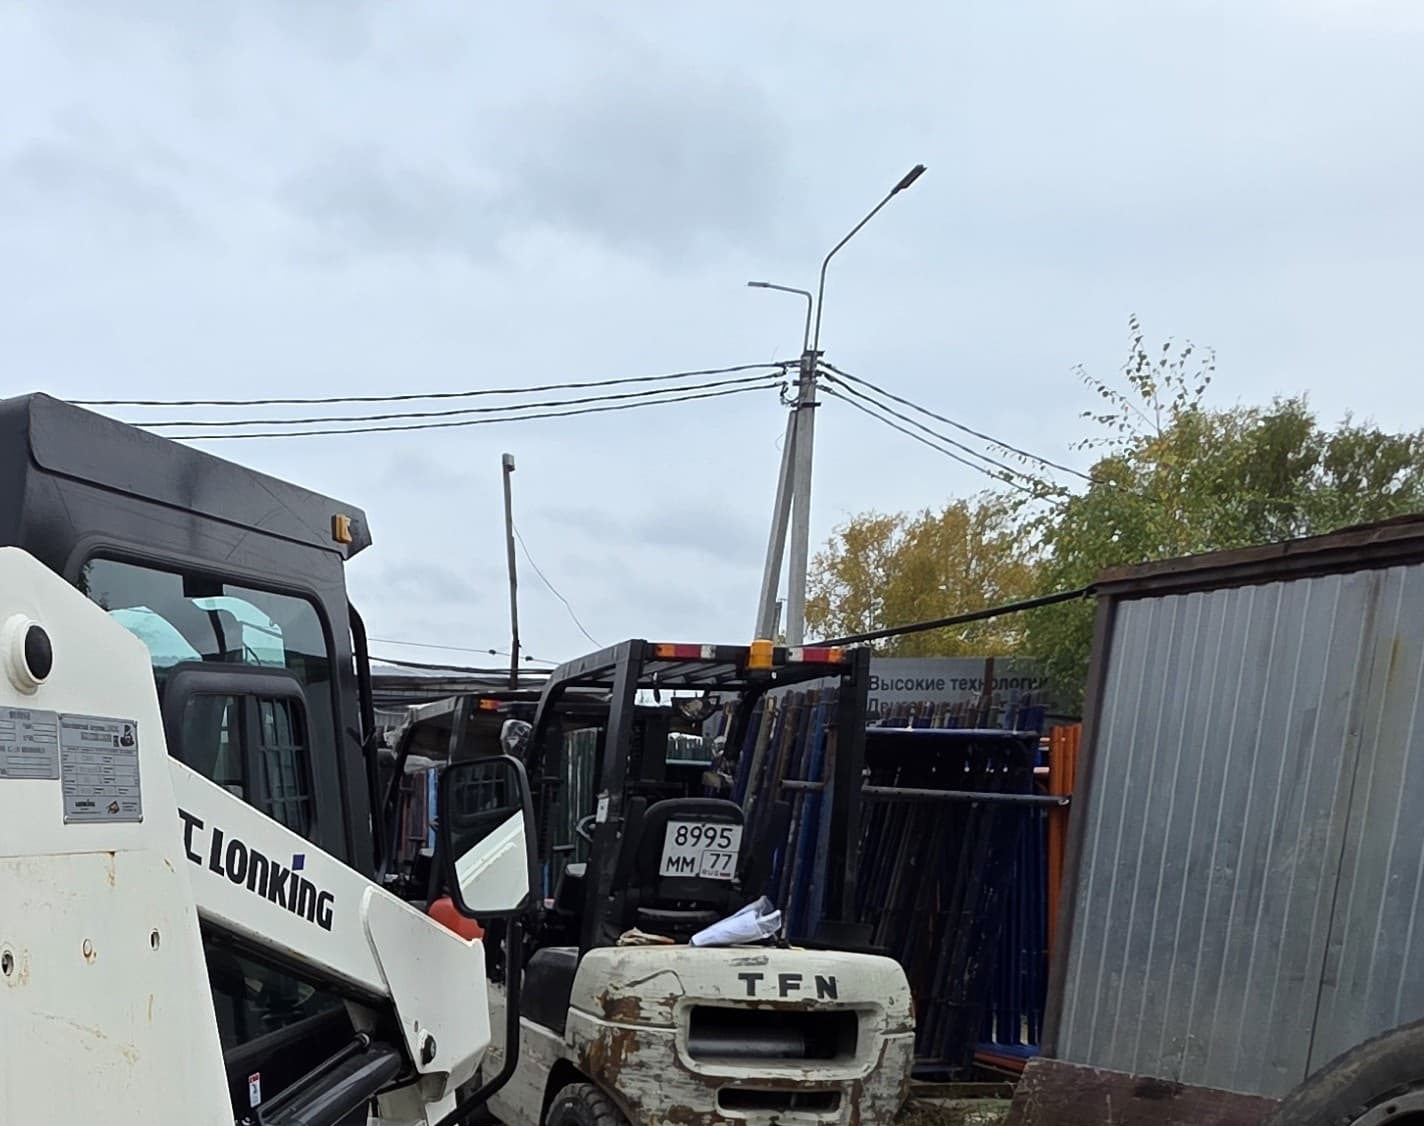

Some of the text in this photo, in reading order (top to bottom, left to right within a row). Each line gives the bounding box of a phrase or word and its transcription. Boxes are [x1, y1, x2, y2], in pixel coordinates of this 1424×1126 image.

[869, 675, 945, 692] Высокие
[675, 825, 733, 849] 8995
[710, 853, 732, 870] 77
